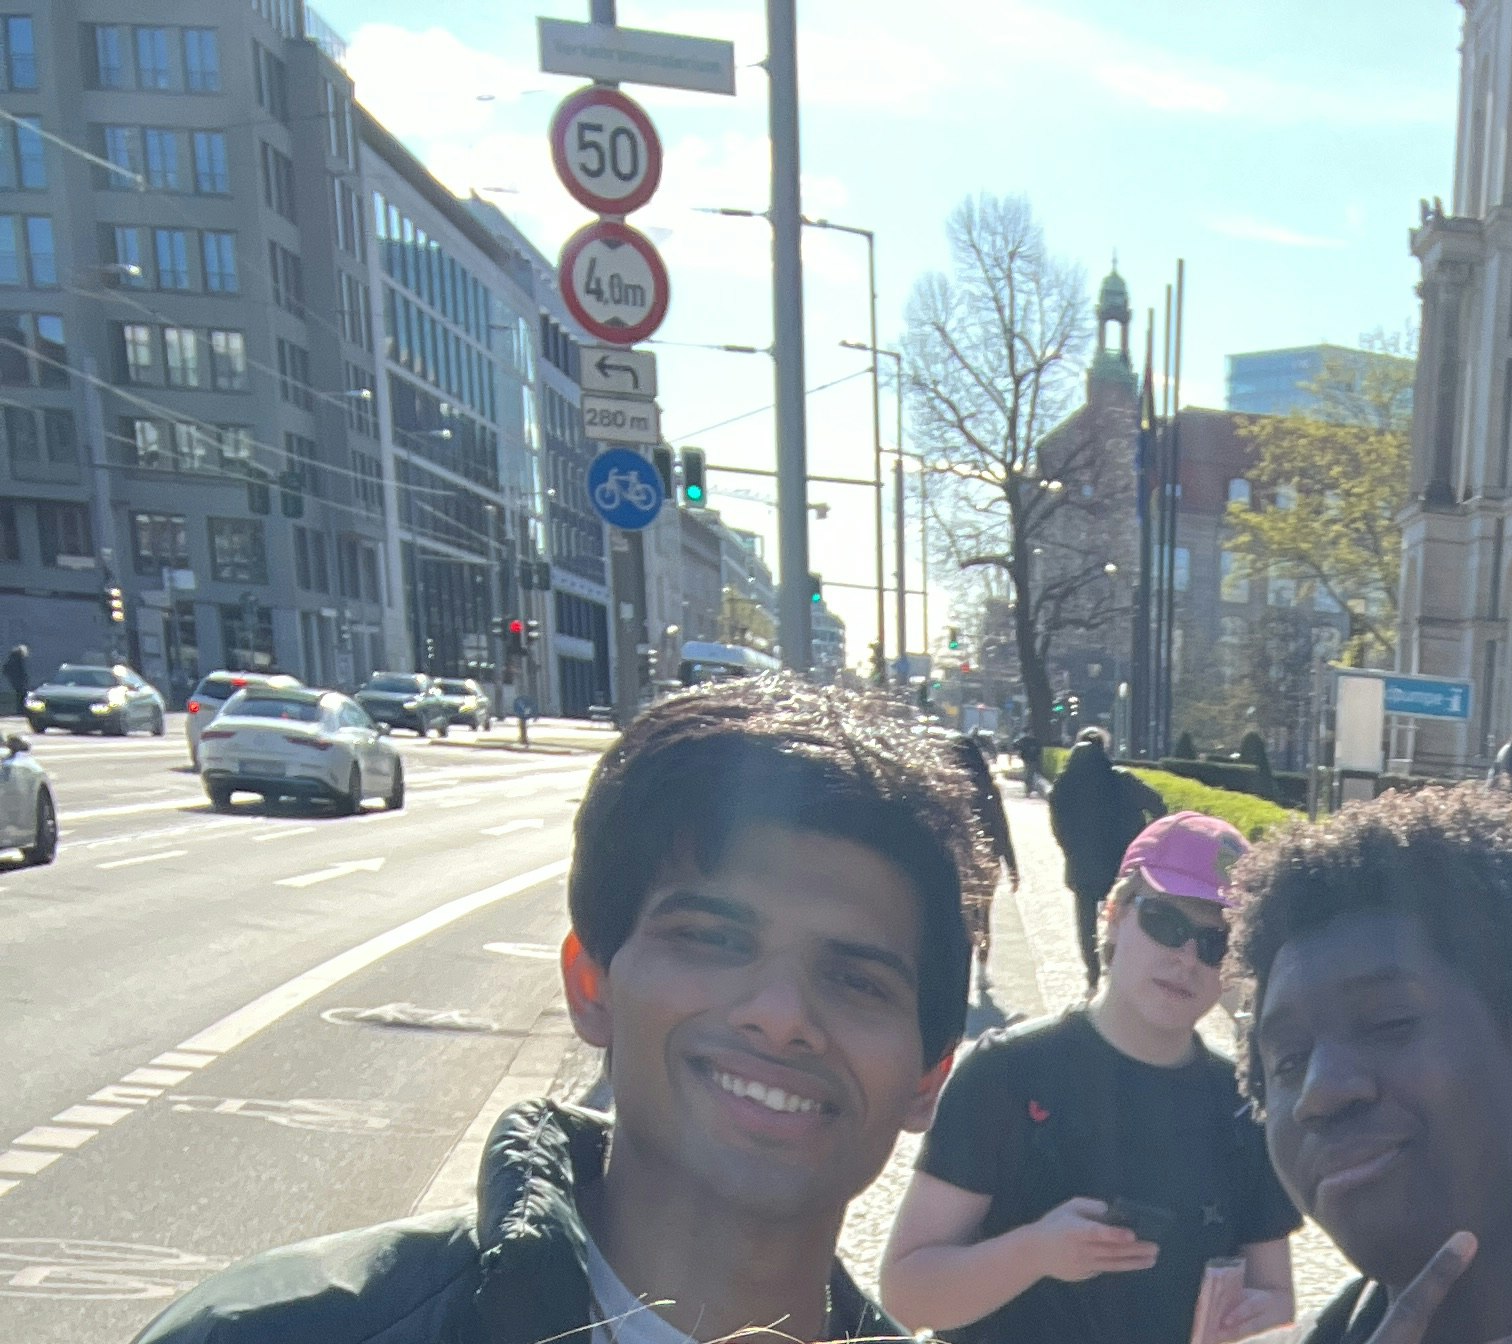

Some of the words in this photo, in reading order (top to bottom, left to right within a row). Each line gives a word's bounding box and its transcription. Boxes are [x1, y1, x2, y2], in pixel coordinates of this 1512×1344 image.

[576, 121, 640, 182] 50
[585, 407, 626, 428] 280
[629, 414, 649, 431] m
